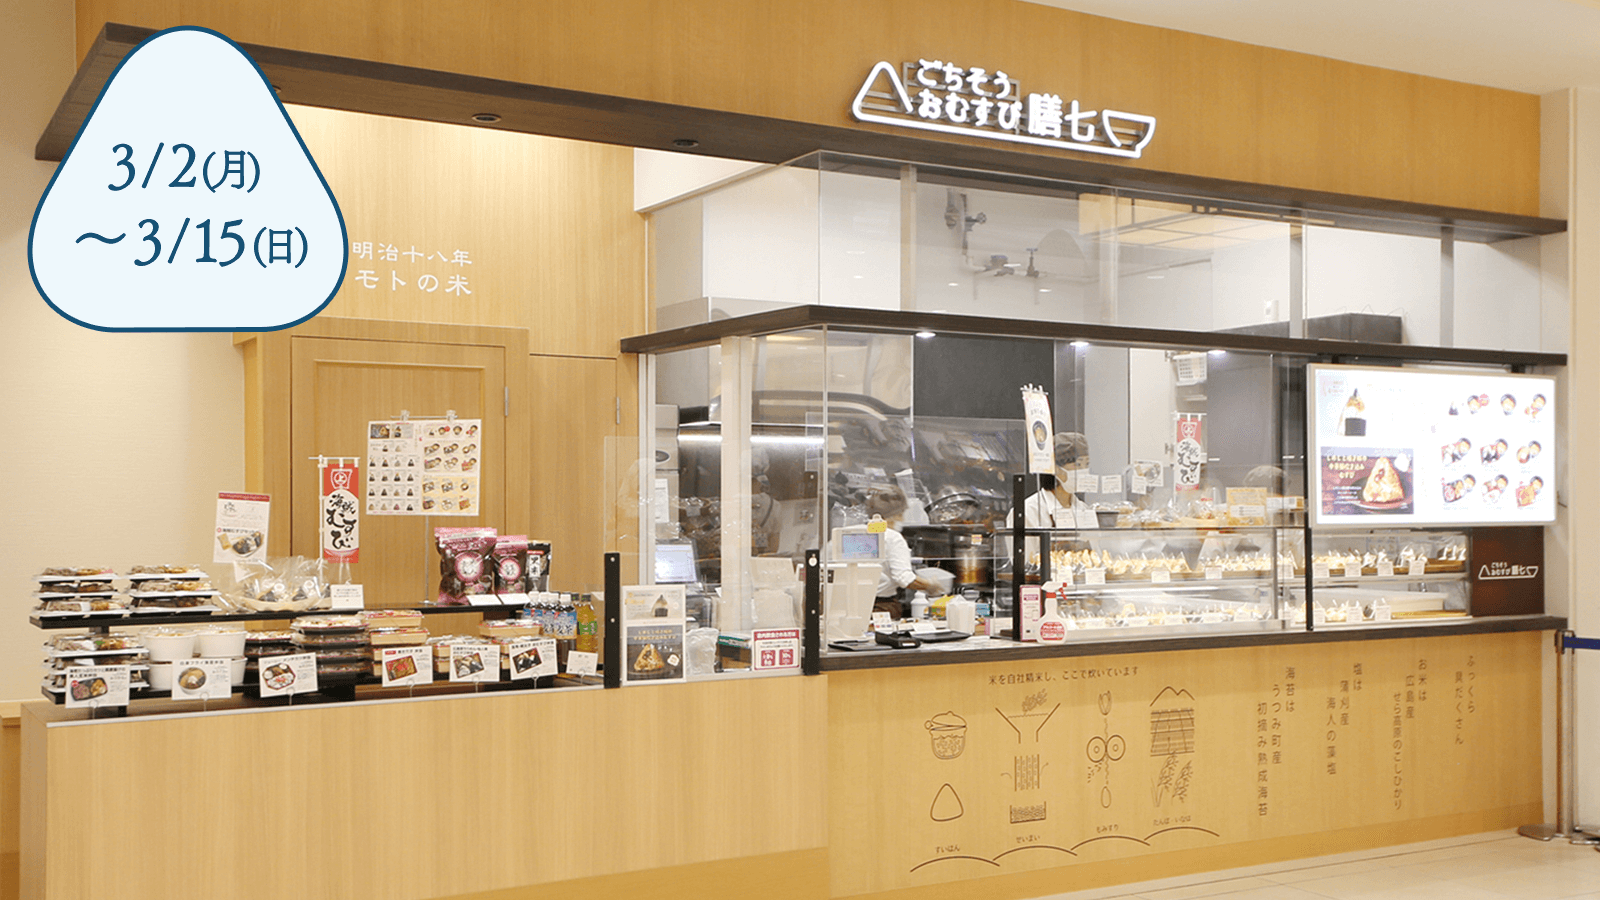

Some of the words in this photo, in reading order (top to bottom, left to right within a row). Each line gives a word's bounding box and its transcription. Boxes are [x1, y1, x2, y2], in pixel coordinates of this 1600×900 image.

[917, 58, 1011, 99] ごちそう
[918, 88, 1023, 130] おむすび
[1028, 92, 1098, 142] 膳七
[352, 241, 473, 267] 明治十八年
[354, 270, 473, 297] モトの米
